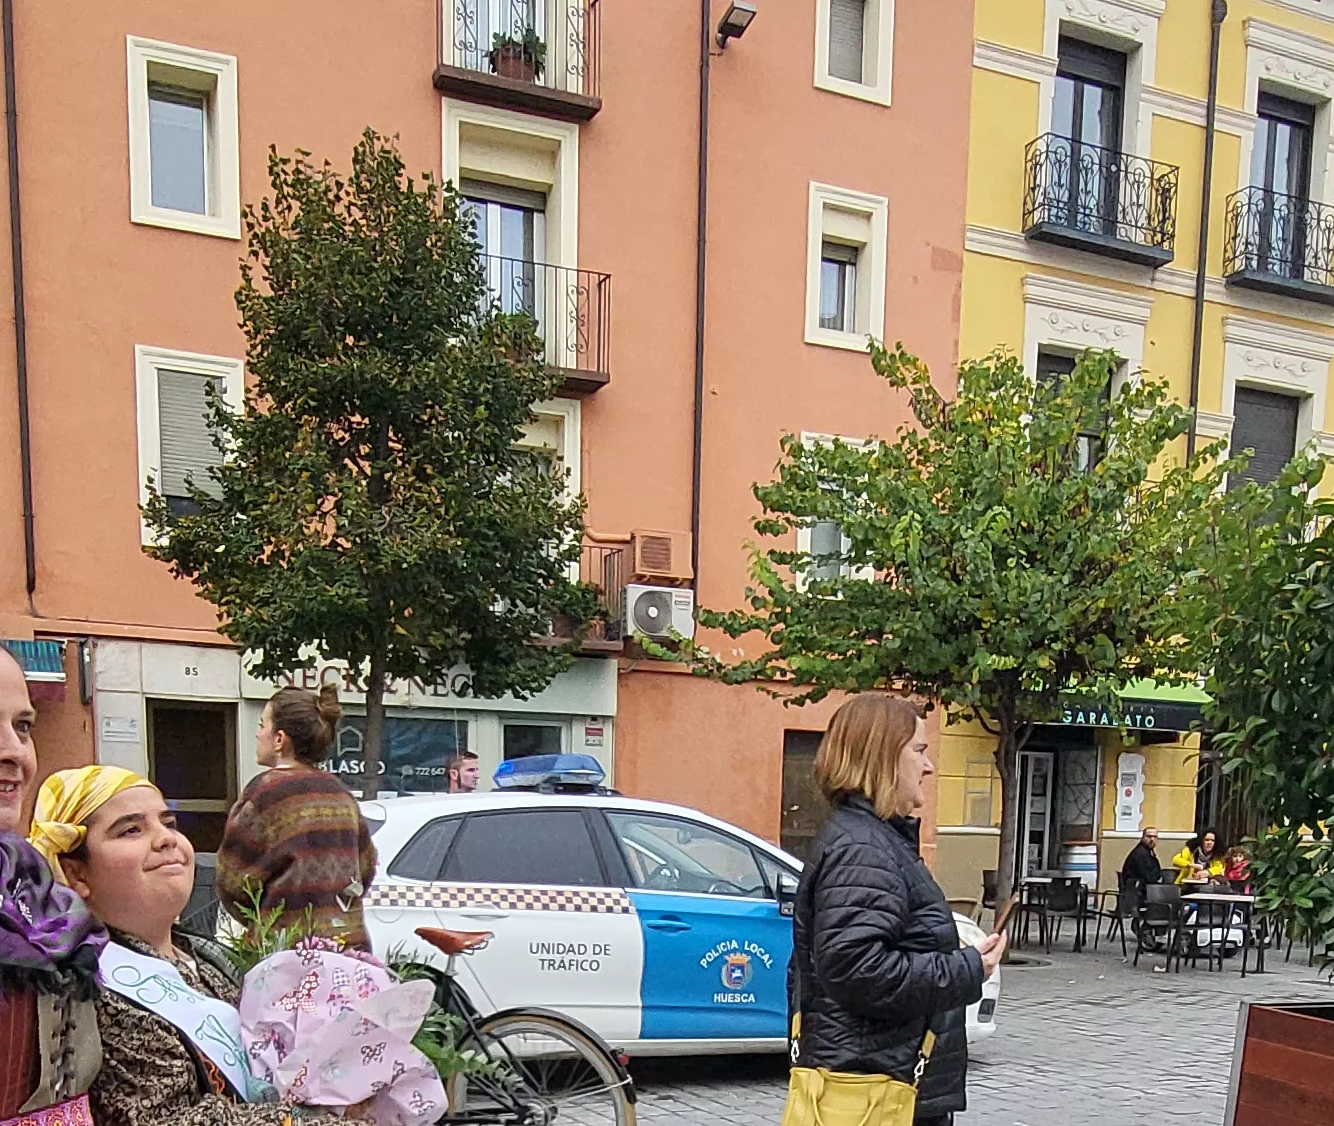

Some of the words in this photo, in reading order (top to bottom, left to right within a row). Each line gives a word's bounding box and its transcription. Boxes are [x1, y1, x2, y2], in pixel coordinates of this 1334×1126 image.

[529, 942, 588, 956] UNIDAD
[592, 943, 612, 956] DE
[744, 940, 774, 970] LOCAL
[538, 956, 601, 972] TRÁFICO
[713, 992, 756, 1003] HUESCA
